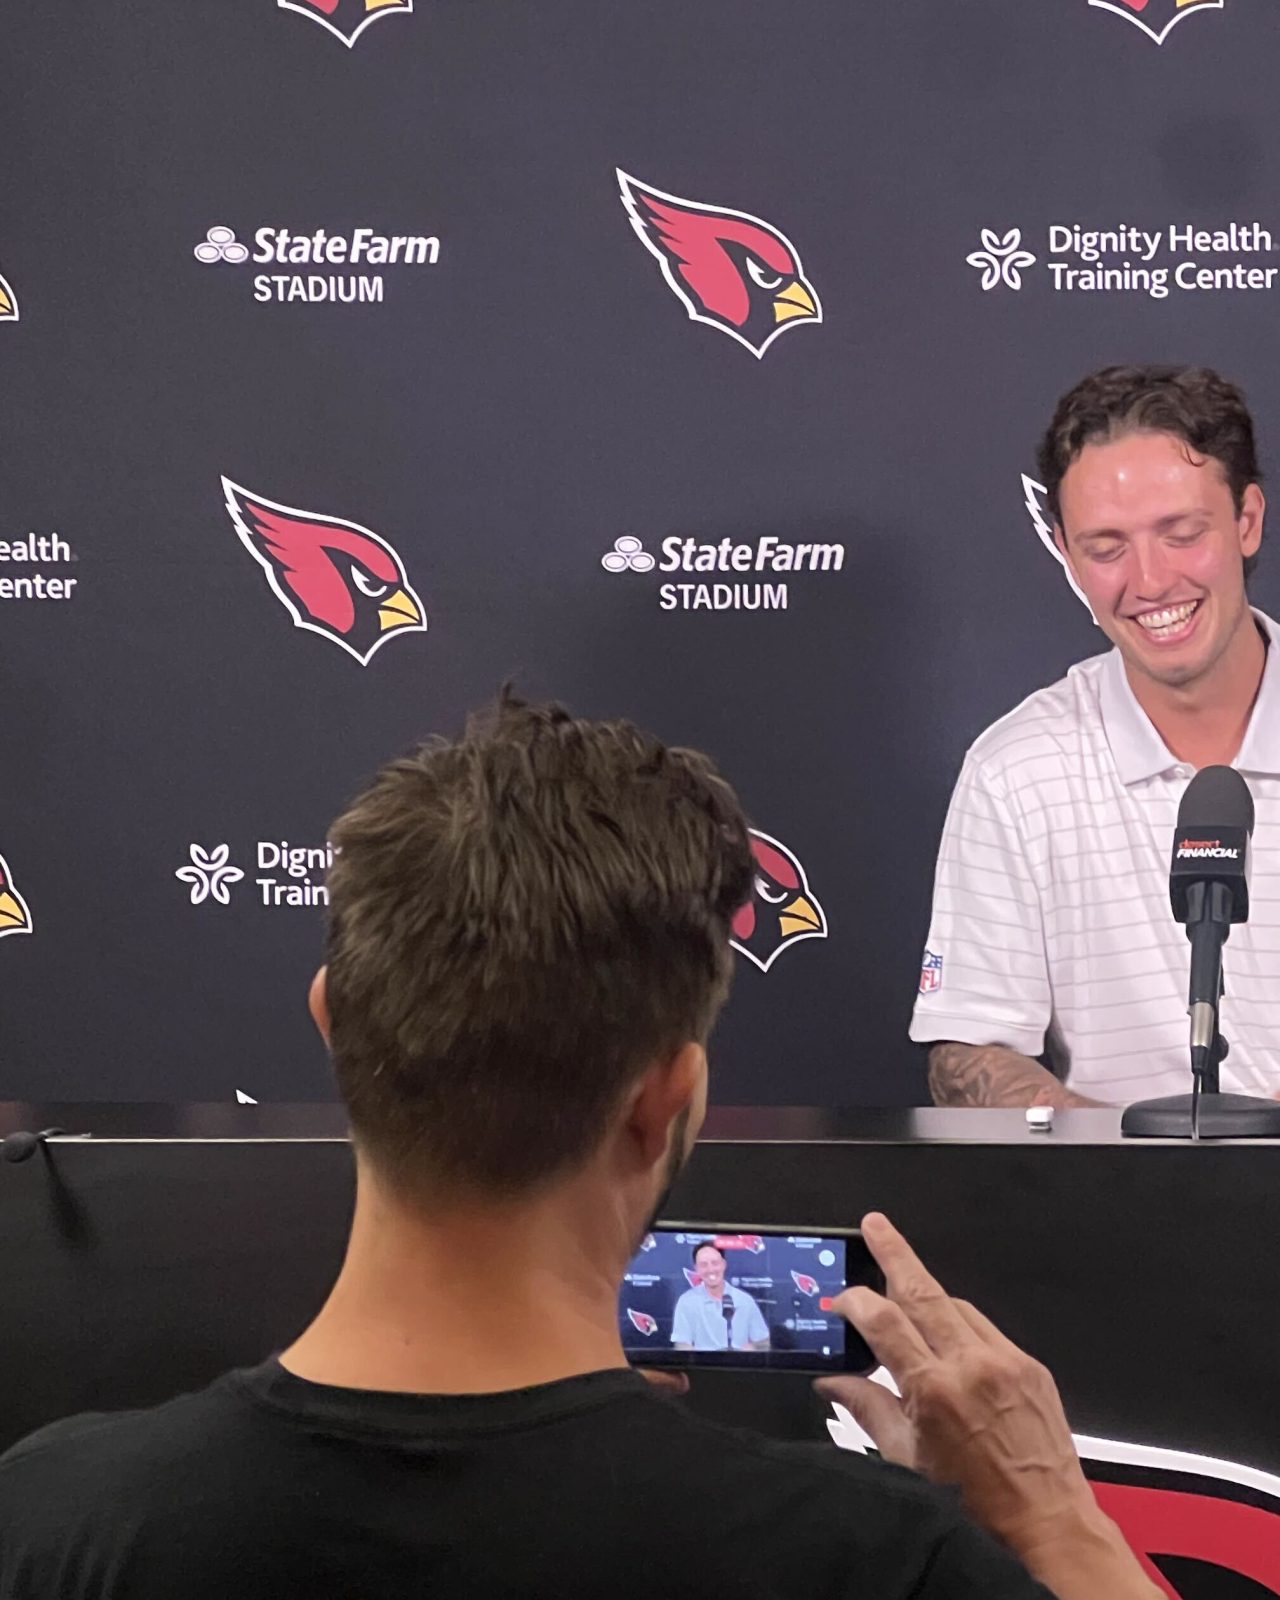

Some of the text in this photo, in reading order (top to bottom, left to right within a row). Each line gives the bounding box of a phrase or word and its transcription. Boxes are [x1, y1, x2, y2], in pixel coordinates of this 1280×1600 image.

[1049, 222, 1272, 261] Dignity Health
[253, 275, 384, 302] STADIUM
[1047, 261, 1279, 299] Training Center
[659, 583, 788, 610] STADIUM
[1176, 847, 1239, 859] FINANCIAL
